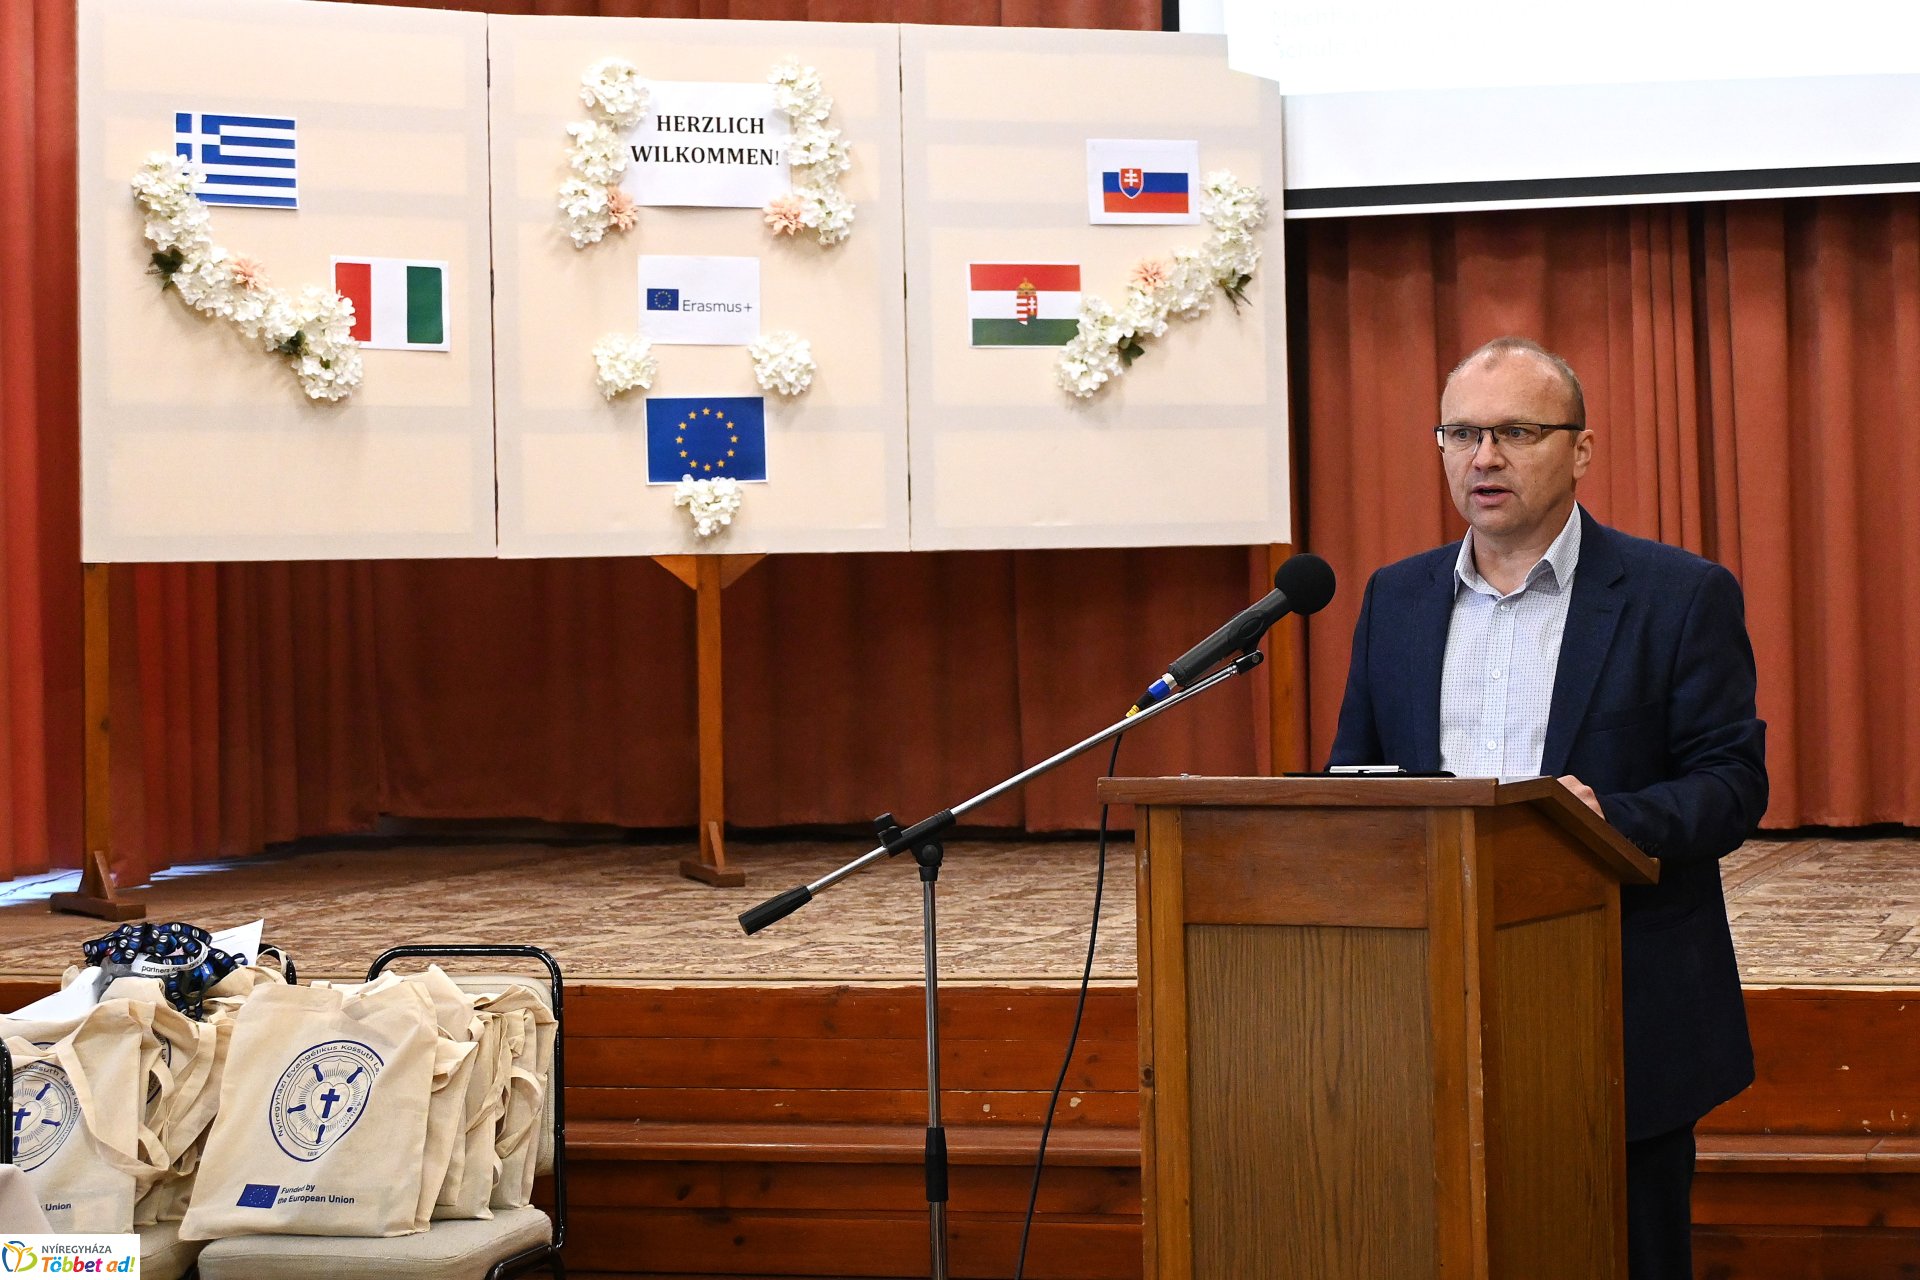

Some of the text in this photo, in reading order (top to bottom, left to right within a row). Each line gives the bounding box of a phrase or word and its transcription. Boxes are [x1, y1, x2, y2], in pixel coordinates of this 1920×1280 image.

[656, 114, 765, 135] HERZLICH
[630, 145, 780, 166] WILKOMMEN!
[682, 299, 753, 313] Erasmus+
[340, 1044, 375, 1062] Kossuth
[281, 1183, 316, 1195] Funded by
[288, 1194, 326, 1204] European
[328, 1194, 355, 1204] Union
[45, 1202, 72, 1212] Union
